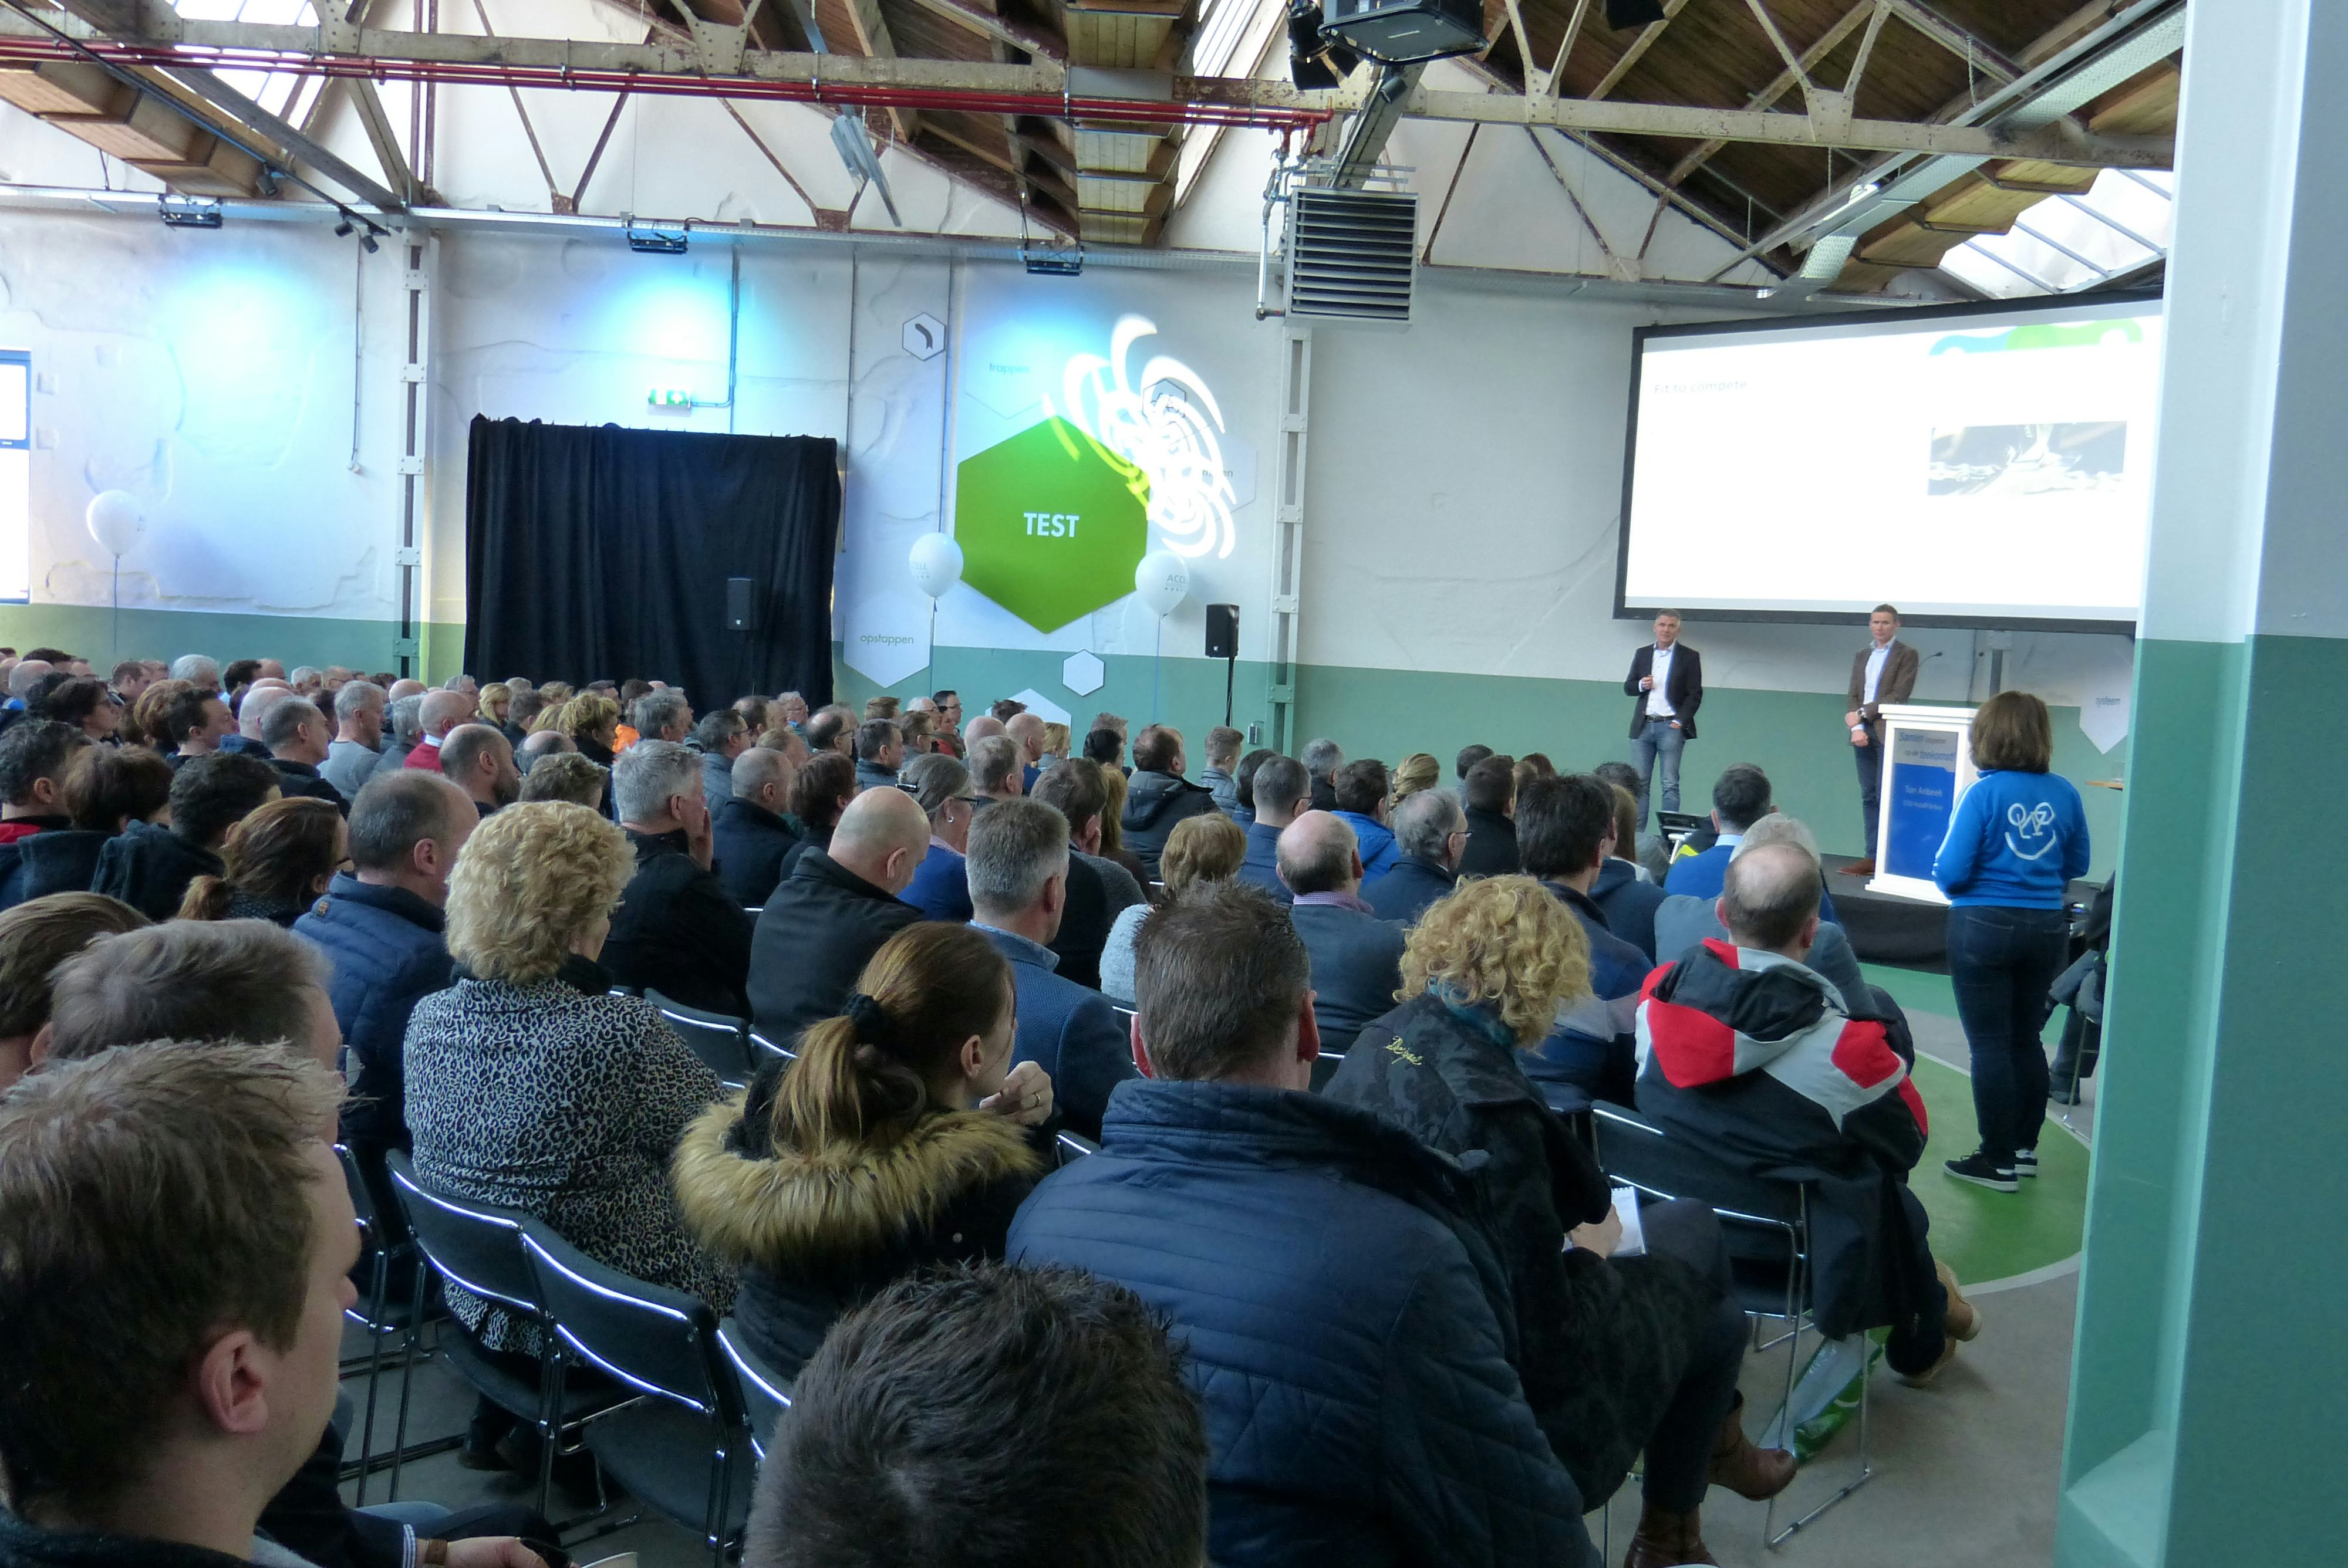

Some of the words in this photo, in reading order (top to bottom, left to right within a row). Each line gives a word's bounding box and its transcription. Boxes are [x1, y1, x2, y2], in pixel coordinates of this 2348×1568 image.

[1654, 384, 1669, 393] Fit
[1674, 384, 1686, 393] to
[1691, 381, 1747, 394] compete
[1023, 512, 1080, 538] TEST
[860, 634, 914, 646] opstappen
